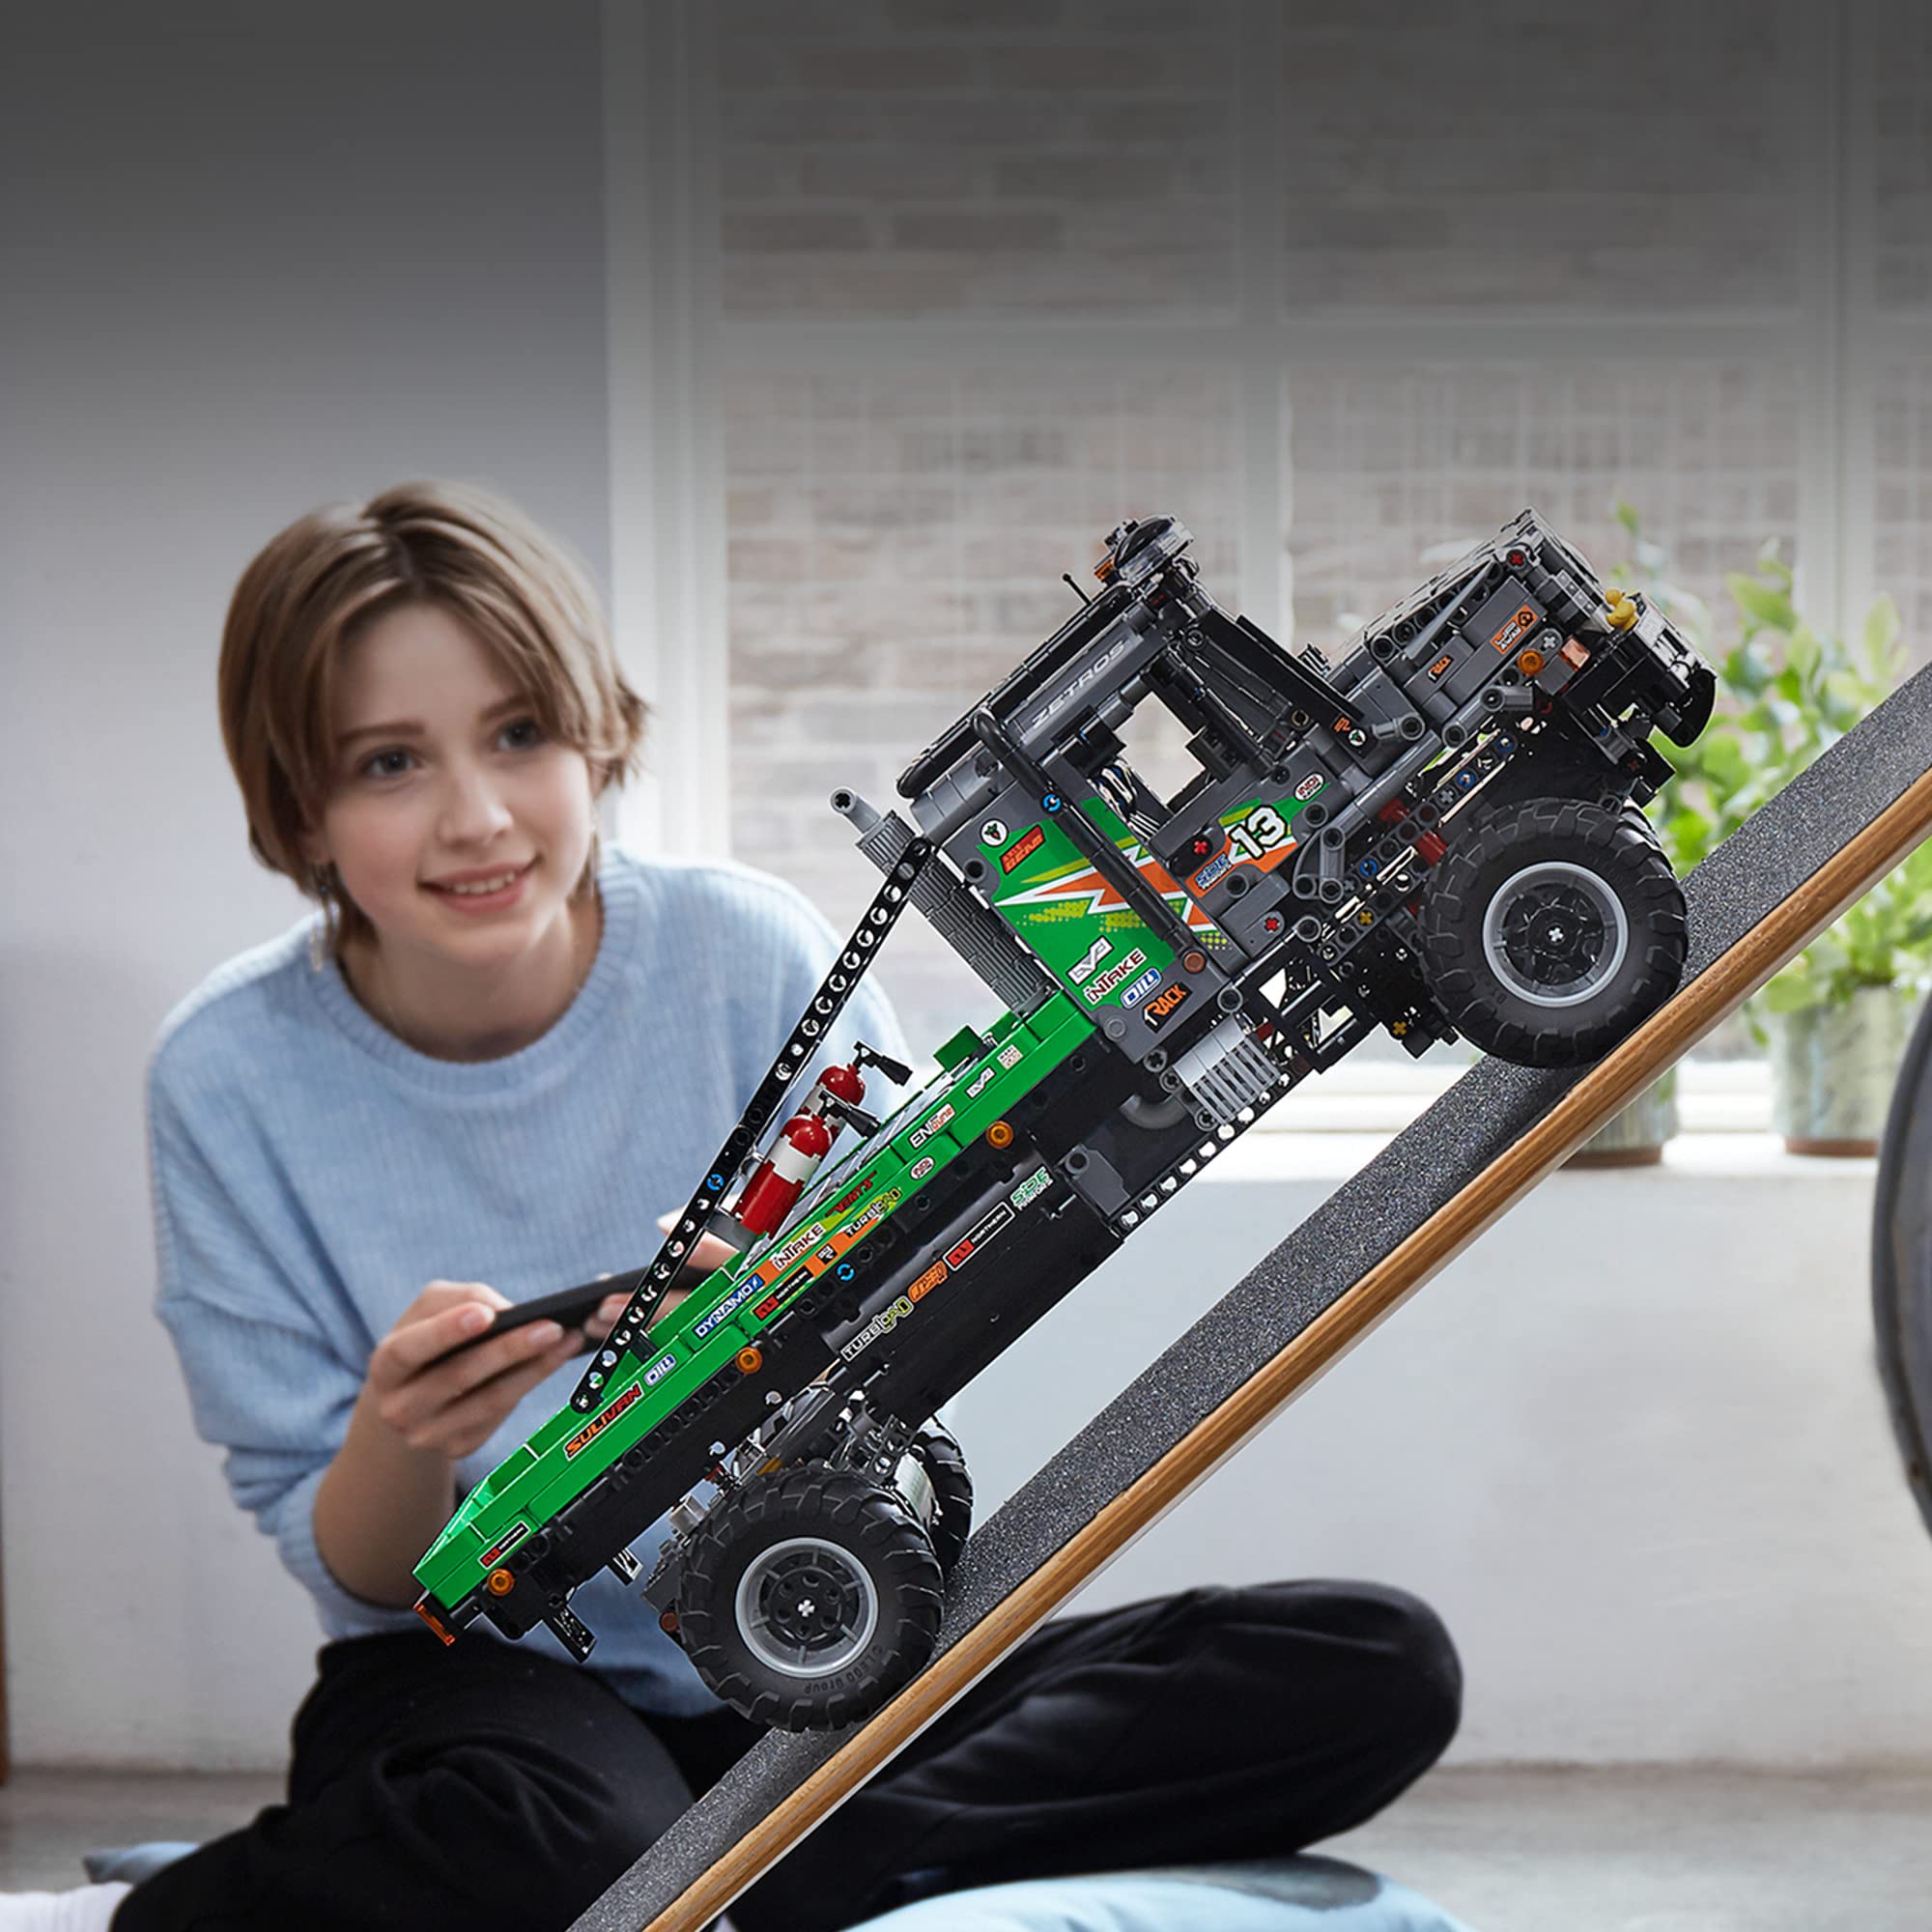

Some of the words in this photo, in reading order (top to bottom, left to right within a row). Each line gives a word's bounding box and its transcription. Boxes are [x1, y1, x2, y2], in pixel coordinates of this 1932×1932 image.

[1032, 640, 1127, 729] ZETROS
[1230, 807, 1286, 858] 13
[972, 1210, 1007, 1243] NORTHERN
[695, 1286, 753, 1337] DYNAMO
[566, 1383, 641, 1459] SULIVAN
